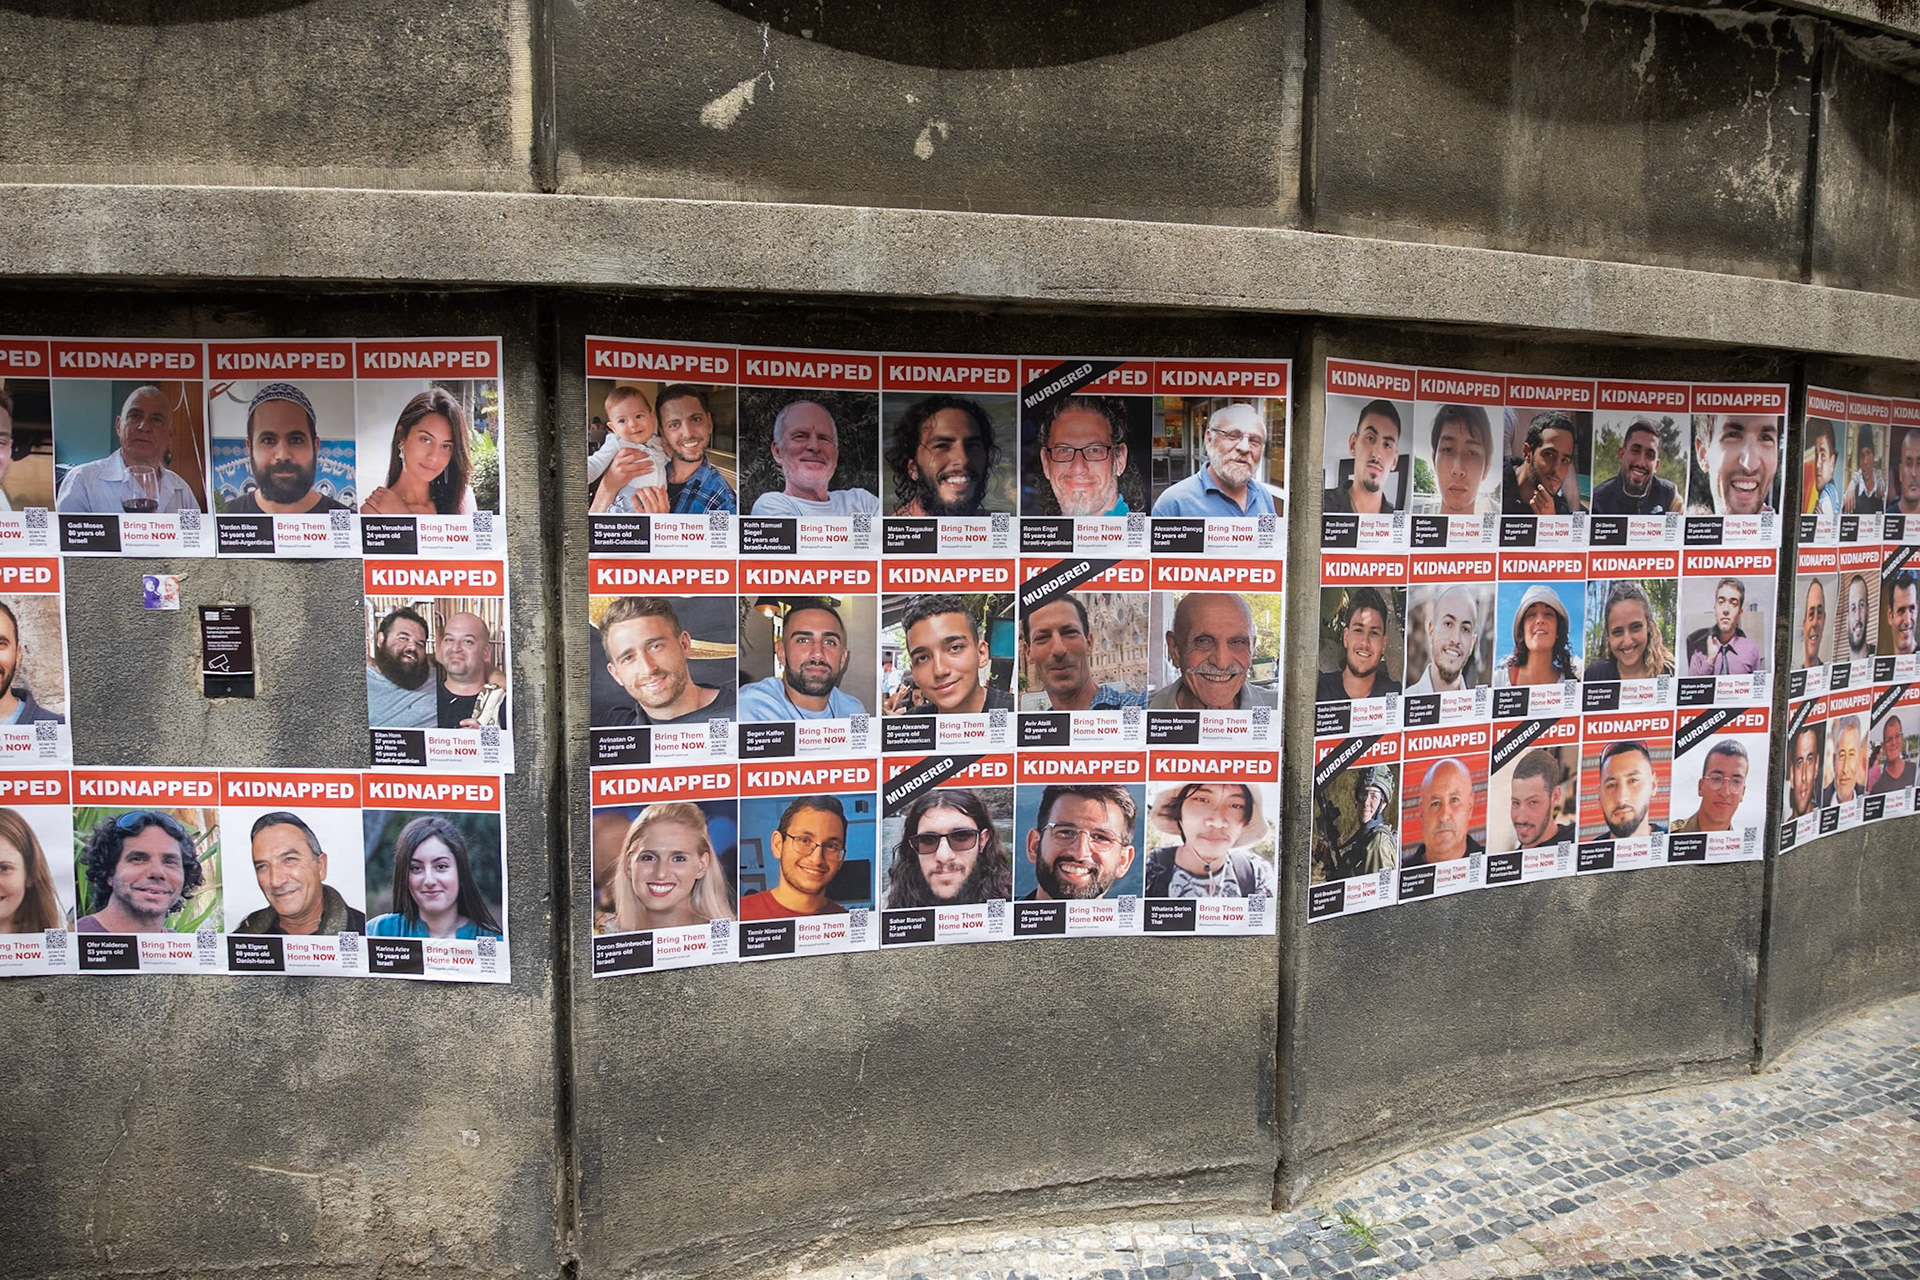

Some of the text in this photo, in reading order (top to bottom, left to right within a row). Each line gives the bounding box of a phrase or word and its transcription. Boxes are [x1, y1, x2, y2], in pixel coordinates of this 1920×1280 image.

[60, 352, 195, 369] KIDNAPPED
[217, 353, 346, 370] KIDNAPPED
[364, 352, 490, 368] KIDNAPPED
[595, 350, 729, 374] KIDNAPPED
[746, 359, 872, 380] KIDNAPPED
[889, 365, 1011, 383] KIDNAPPED
[1024, 363, 1093, 408] MURDERED
[1161, 370, 1280, 387] KIDNAPPED
[1331, 370, 1411, 391] KIDNAPPED
[1421, 379, 1500, 397] KIDNAPPED
[1510, 385, 1590, 402] KIDNAPPED
[1601, 389, 1685, 405] KIDNAPPED
[1696, 393, 1781, 407] KIDNAPPED
[1809, 396, 1844, 413] KIDNAPPED
[1849, 402, 1889, 417] KIDNAPPED
[124, 522, 146, 530] Bring
[655, 523, 677, 531] Bring
[1208, 525, 1229, 533] Bring
[1592, 558, 1675, 571] KIDNAPPED
[1687, 556, 1773, 569] KIDNAPPED
[1799, 554, 1835, 567] KIDNAPPED
[1840, 552, 1879, 564] KIDNAPPED
[1882, 547, 1910, 579] MURDERED
[1326, 562, 1404, 576] KIDNAPPED
[1413, 561, 1492, 575] KIDNAPPED
[1503, 560, 1583, 573] KIDNAPPED
[372, 569, 498, 586] KIDNAPPED
[597, 569, 729, 585] KIDNAPPED
[746, 569, 870, 585] KIDNAPPED
[889, 568, 1008, 583] KIDNAPPED
[1158, 567, 1276, 583] KIDNAPPED
[1022, 561, 1091, 606] MURDERED
[1830, 695, 1870, 711] KIDNAPPED
[1872, 686, 1901, 720] MURDERED
[1587, 718, 1670, 734] KIDNAPPED
[1677, 710, 1727, 747] MURDERED
[1408, 731, 1486, 752] KIDNAPPED
[1493, 721, 1540, 763] MURDERED
[1024, 760, 1140, 775] KIDNAPPED
[1156, 758, 1272, 774] KIDNAPPED
[1316, 739, 1363, 785] MURDERED
[600, 773, 731, 796] KIDNAPPED
[748, 768, 870, 787] KIDNAPPED
[885, 757, 954, 804] MURDERED
[80, 780, 214, 797] KIDNAPPED
[228, 781, 355, 799] KIDNAPPED
[370, 783, 494, 801] KIDNAPPED
[1069, 907, 1090, 915] Bring
[616, 939, 652, 949] Steinbrecher
[657, 936, 679, 945] Bring
[684, 943, 708, 951] NOW.
[427, 946, 448, 954] Bring
[605, 950, 621, 958] years
